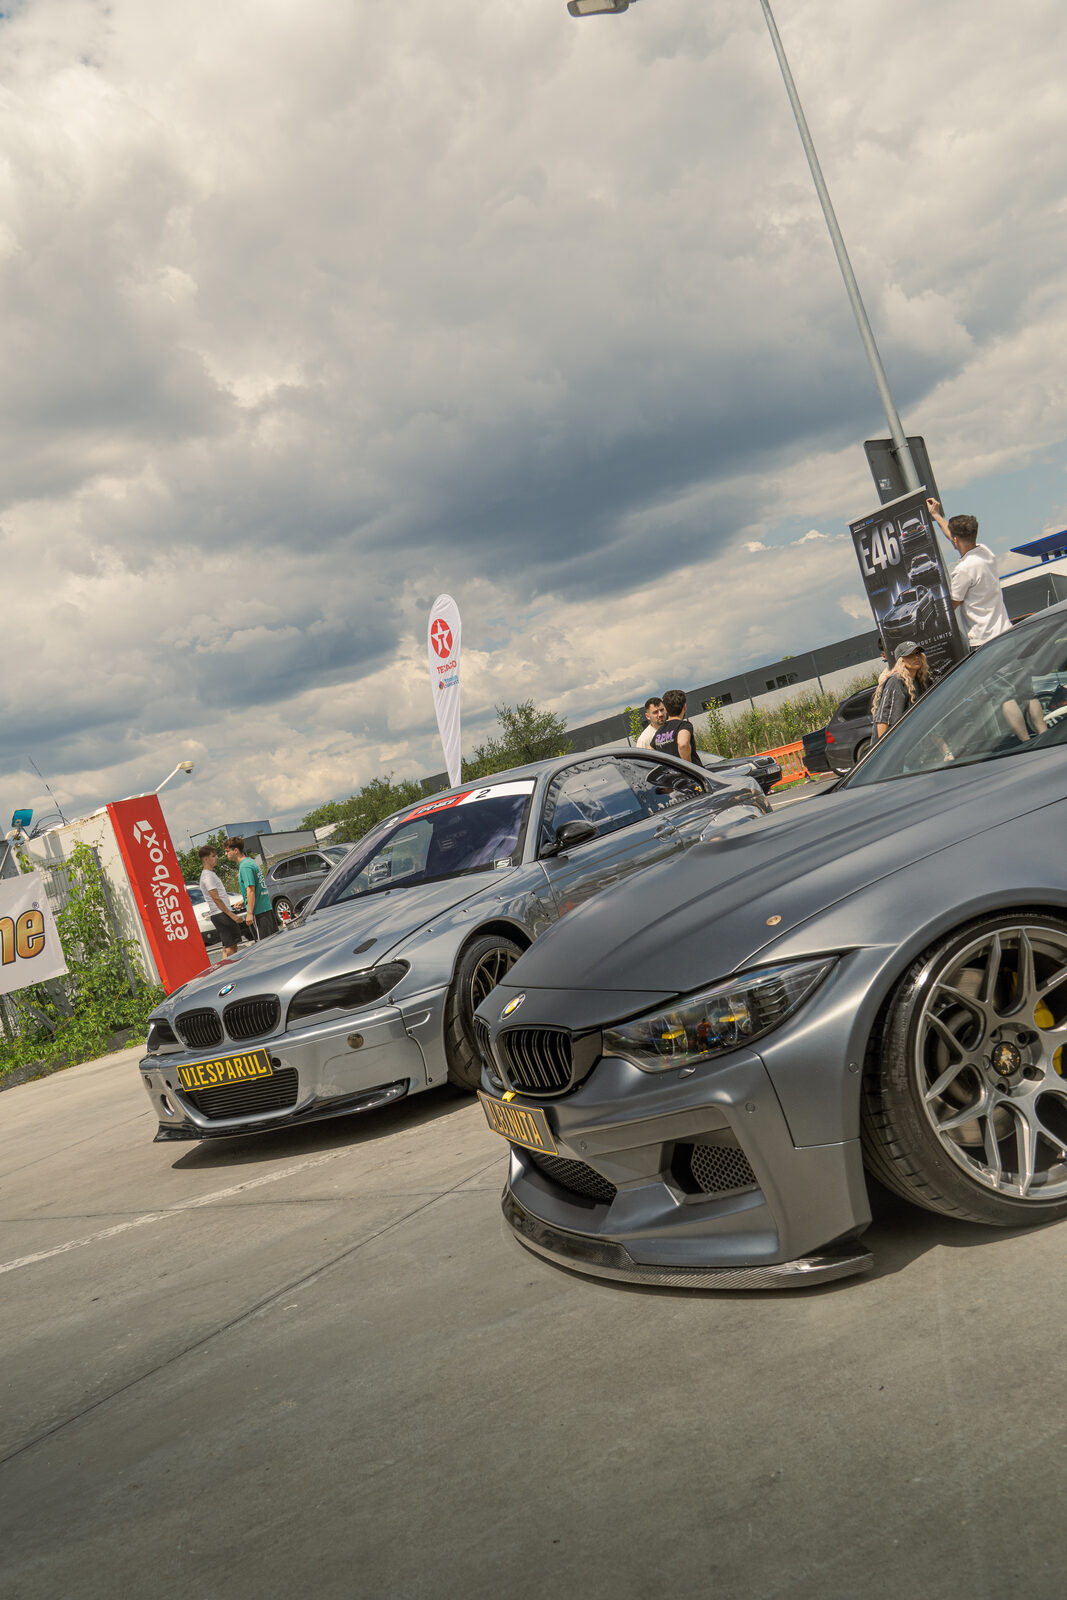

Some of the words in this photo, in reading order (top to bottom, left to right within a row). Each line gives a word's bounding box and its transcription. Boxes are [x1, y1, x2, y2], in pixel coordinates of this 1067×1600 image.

[857, 520, 901, 577] E46
[933, 631, 953, 641] LIMITS
[475, 788, 491, 800] 2
[143, 832, 189, 940] easybox
[150, 884, 176, 942] SAMEDAY
[181, 1053, 267, 1088] VIESPARUL
